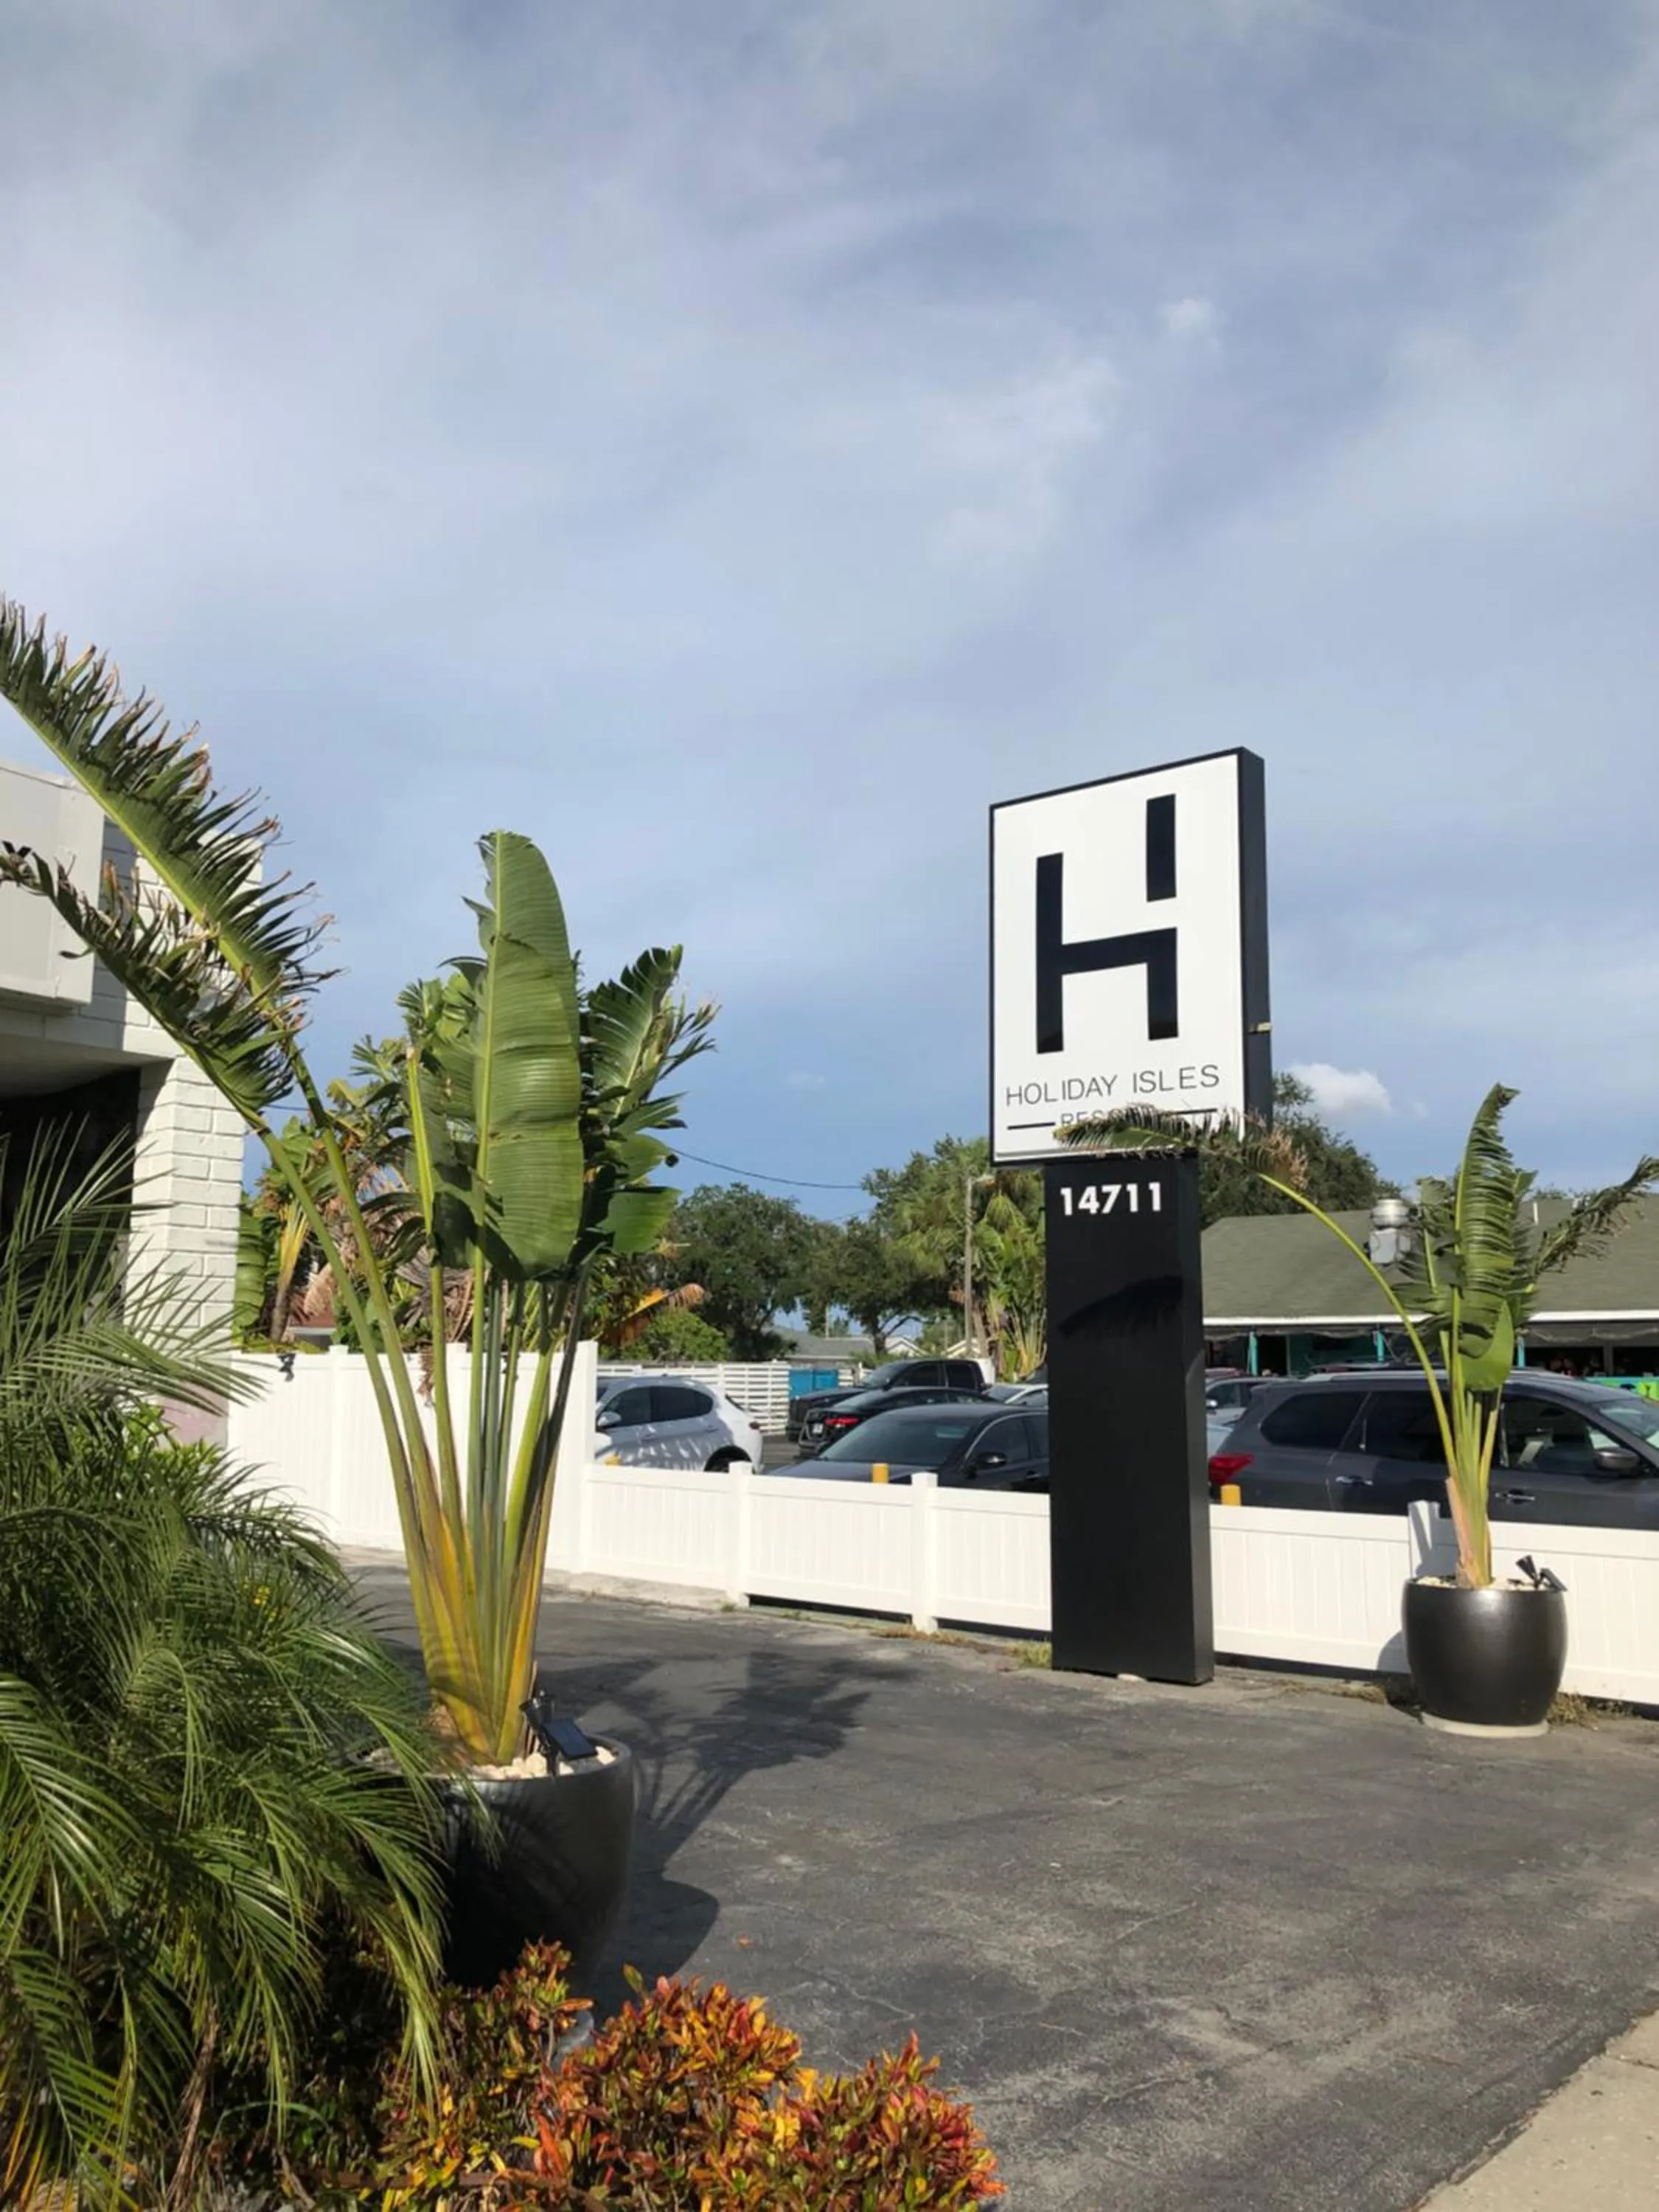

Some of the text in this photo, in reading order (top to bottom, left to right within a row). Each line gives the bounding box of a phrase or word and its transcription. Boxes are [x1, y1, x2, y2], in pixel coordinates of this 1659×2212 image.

[1036, 793, 1178, 1054] H
[1006, 1064, 1220, 1106] HOLIDAY ISLES
[1060, 1182, 1162, 1216] 14711
